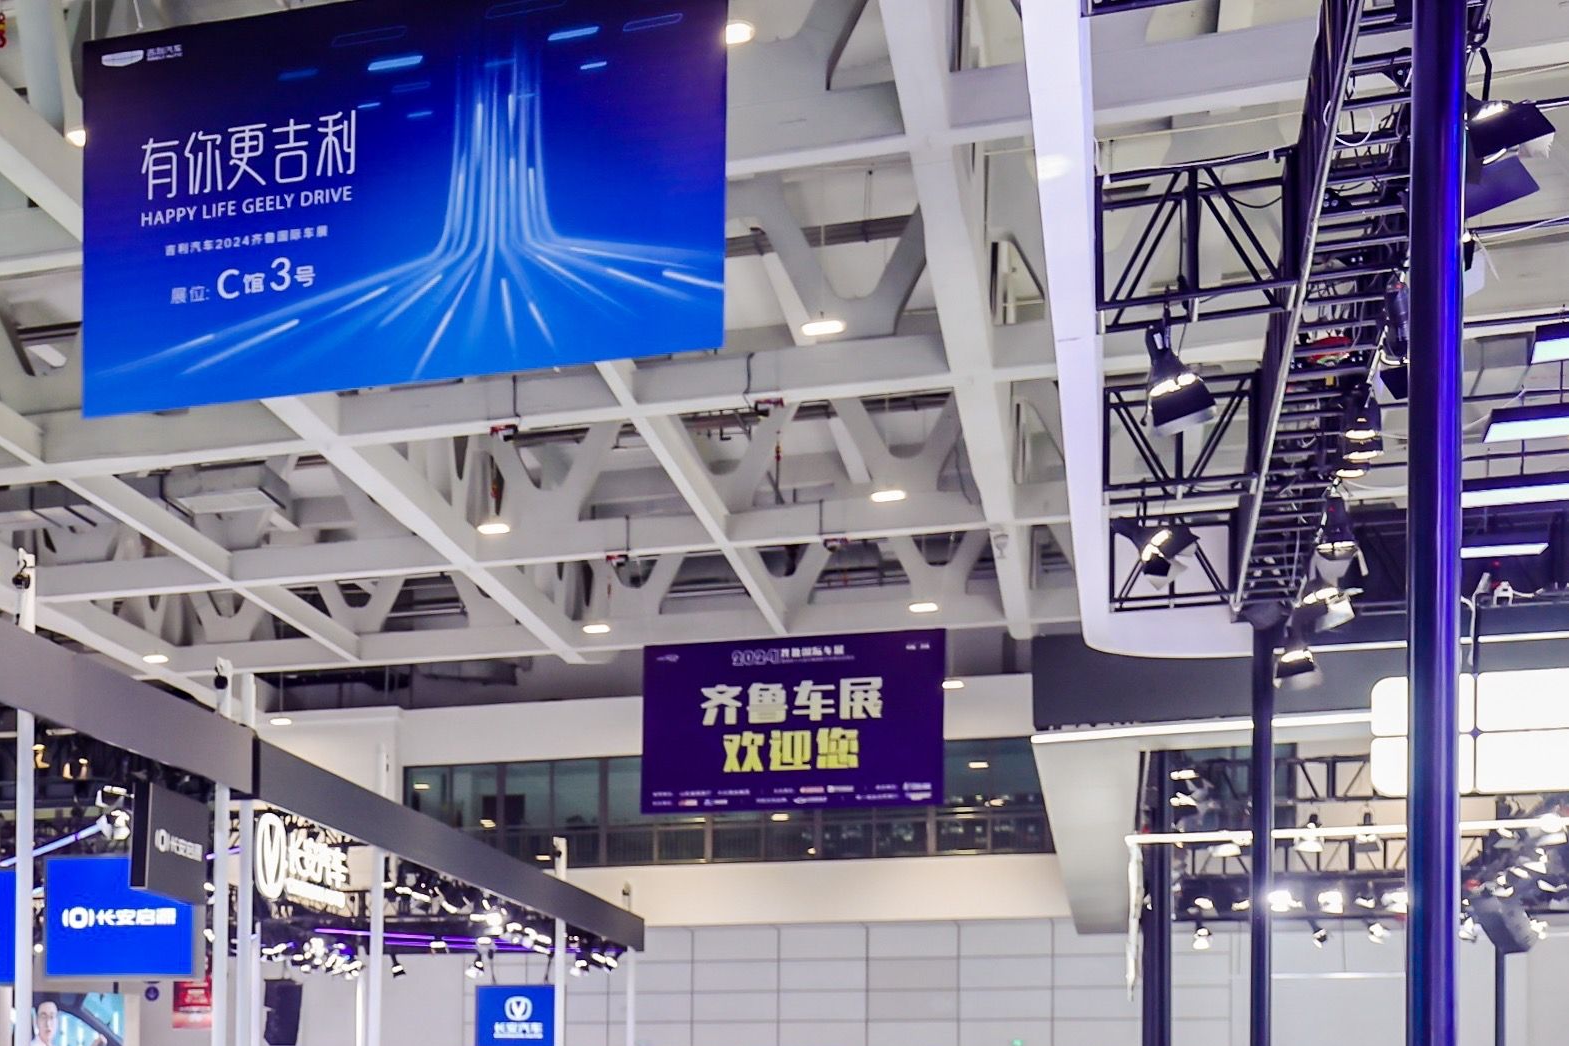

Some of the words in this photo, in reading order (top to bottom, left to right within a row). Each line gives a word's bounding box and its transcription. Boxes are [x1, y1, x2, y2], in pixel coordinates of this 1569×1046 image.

[140, 110, 357, 201] 有你更吉利
[141, 206, 197, 227] HAPPY
[202, 200, 237, 219] LIFE
[242, 193, 295, 214] GEELY
[300, 186, 353, 207] DRIVE
[216, 257, 316, 300] C馆3号
[700, 676, 884, 726] 齐鲁车展
[722, 727, 860, 773] 欢迎您
